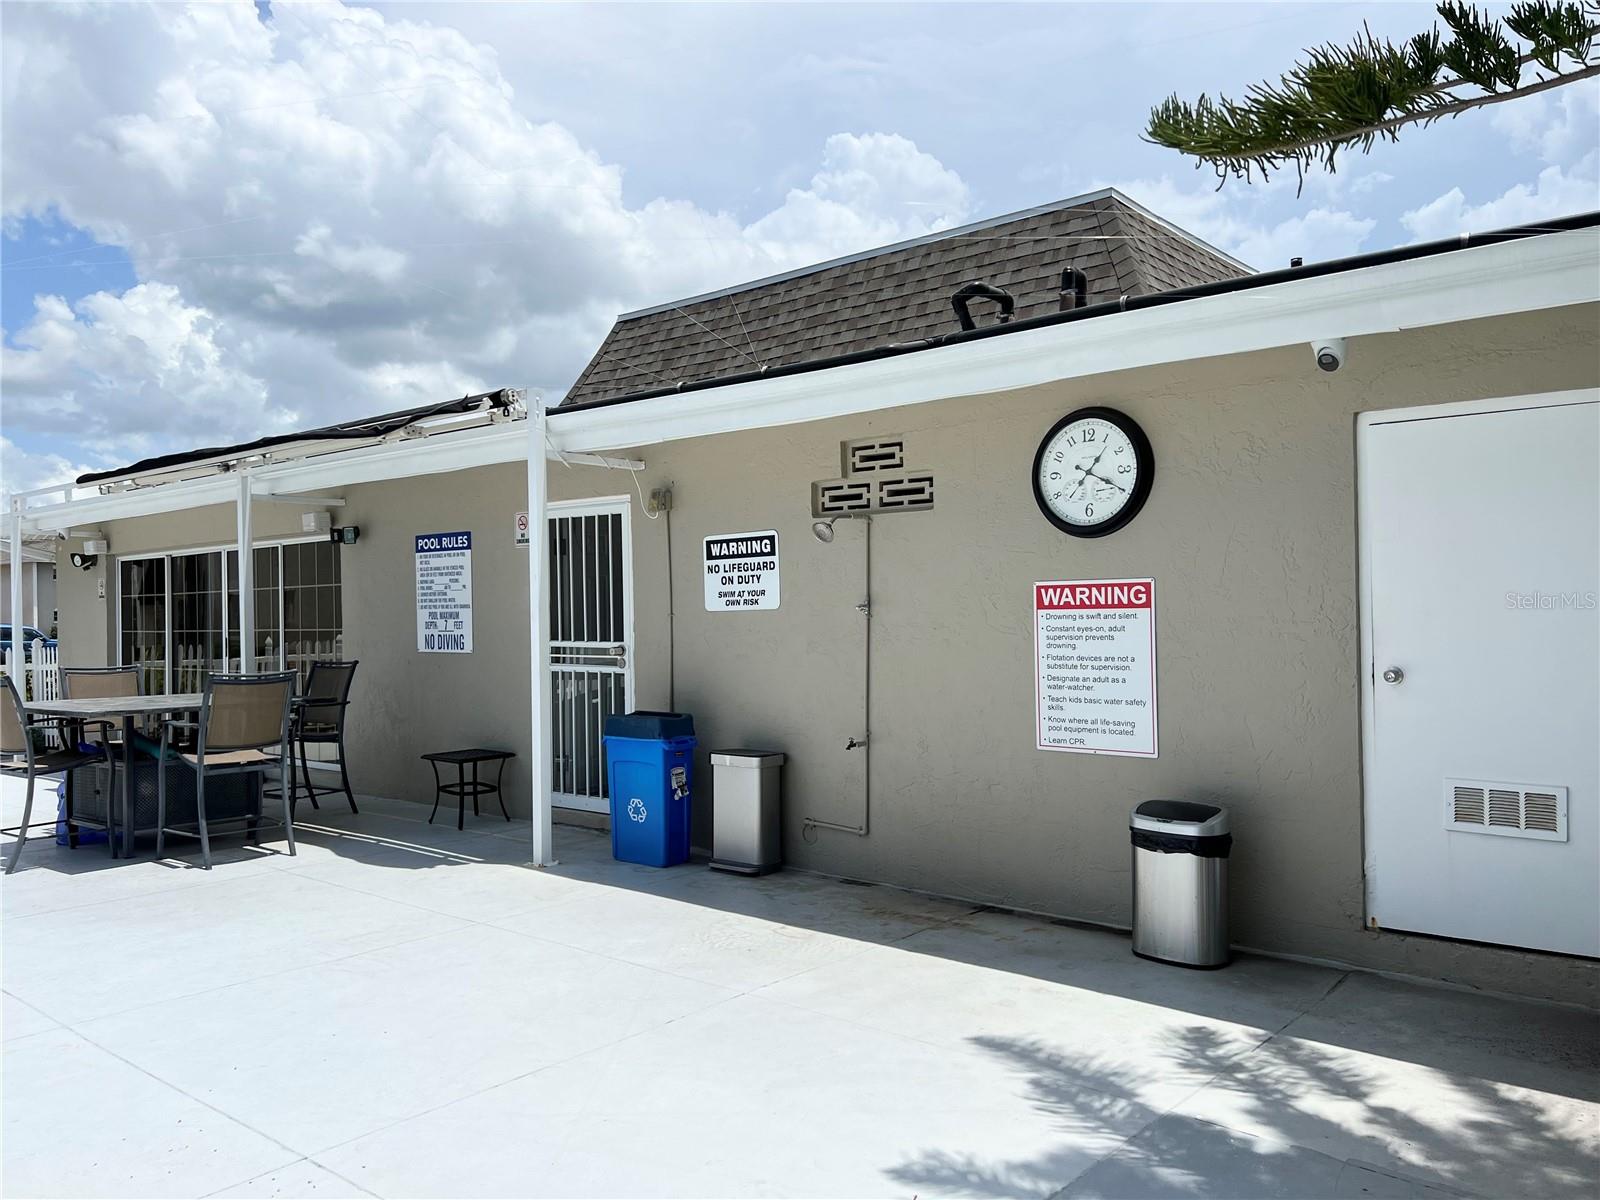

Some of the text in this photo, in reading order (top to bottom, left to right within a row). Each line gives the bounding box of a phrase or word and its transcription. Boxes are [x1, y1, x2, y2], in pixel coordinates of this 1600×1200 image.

[1082, 428, 1096, 442] 12
[1102, 433, 1109, 443] 1
[1066, 436, 1076, 448] 11
[1114, 446, 1124, 456] 2
[1054, 452, 1064, 463] 10
[1117, 464, 1132, 474] 3
[1050, 472, 1062, 480] 9
[1054, 491, 1062, 500] 8
[1085, 503, 1094, 516] 6
[418, 535, 468, 550] POOL RULES
[710, 539, 771, 556] WARNING
[708, 561, 775, 574] NO LIFEGUARD
[721, 574, 761, 585] ON DUTY
[1041, 585, 1146, 606] WARNING
[428, 611, 460, 620] POOL MAXIMUM
[444, 620, 448, 630] 7
[454, 621, 463, 629] FEET
[425, 634, 464, 650] NO DIVING
[1047, 674, 1080, 682] Designate
[1125, 698, 1146, 707] safety
[1100, 719, 1136, 728] life-saving
